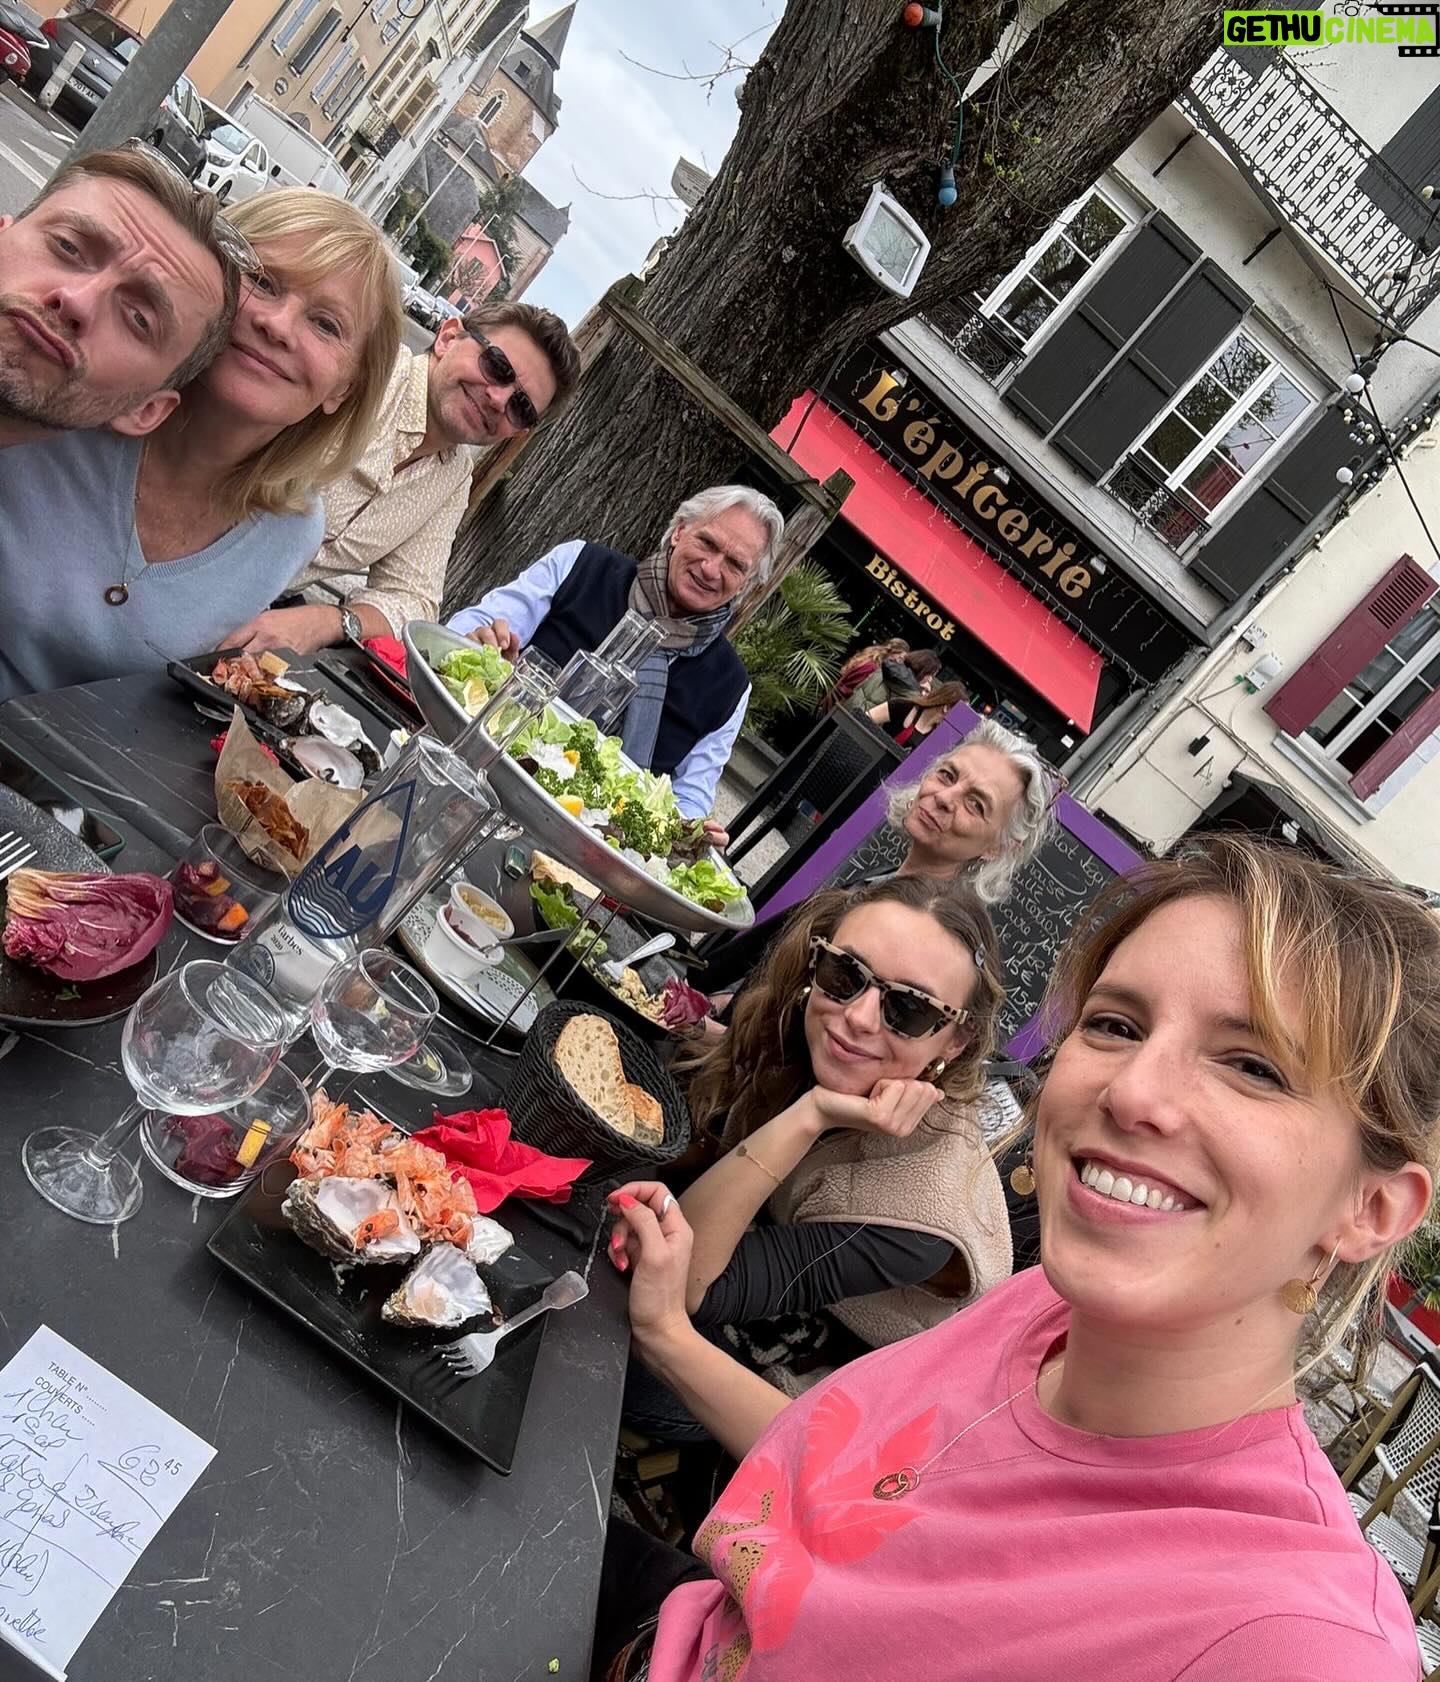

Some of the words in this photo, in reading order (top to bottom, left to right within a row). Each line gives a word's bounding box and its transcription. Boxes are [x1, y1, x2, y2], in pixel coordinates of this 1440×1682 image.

[858, 369, 1092, 600] L'épicerie
[864, 554, 956, 642] Bistrot
[270, 935, 284, 951] 2020
[275, 922, 304, 956] Tarbes
[48, 1361, 77, 1391] TABLE
[34, 1376, 83, 1415] COUVERTS
[163, 1458, 184, 1477] 45
